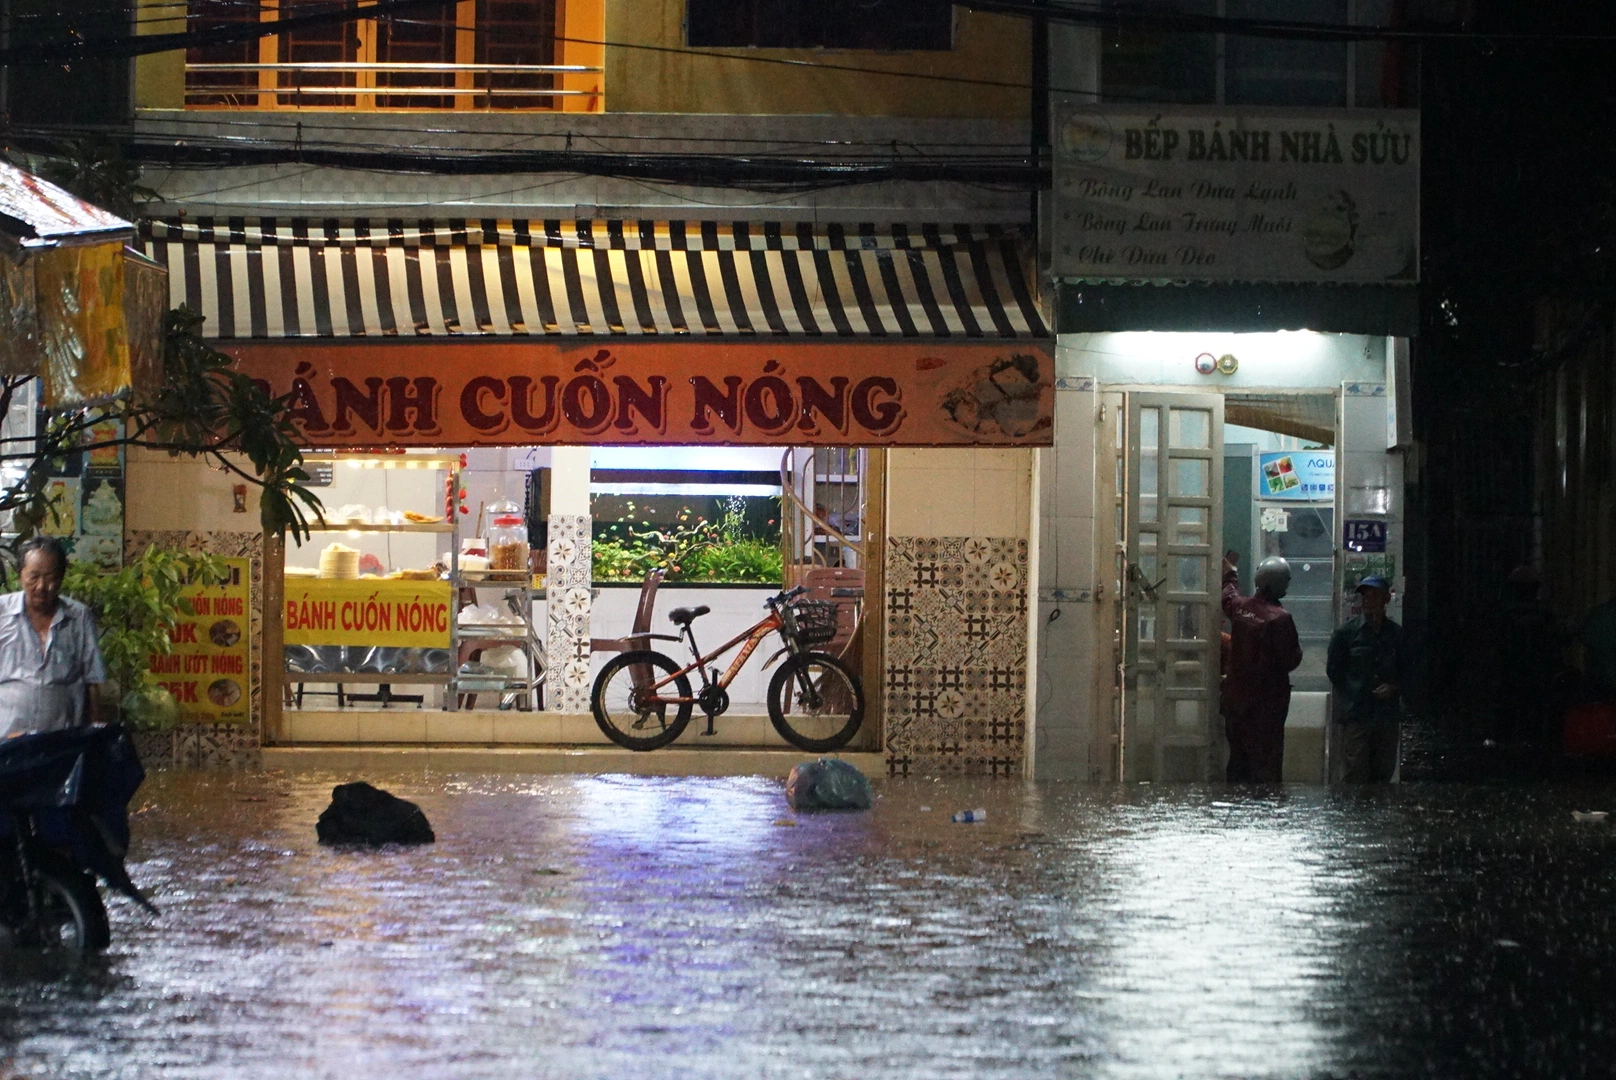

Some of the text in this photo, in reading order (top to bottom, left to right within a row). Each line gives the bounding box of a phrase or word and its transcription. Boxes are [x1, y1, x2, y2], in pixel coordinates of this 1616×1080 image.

[1125, 113, 1411, 165] BẾP BÁNH NHÀ SỬU
[1142, 178, 1183, 198] Lan
[1132, 211, 1172, 232] Lan
[250, 350, 907, 437] ÁNH CUỐN NÓNG
[1348, 523, 1382, 540] 15A
[213, 592, 243, 616] NÓNG
[286, 591, 447, 633] BÁNH CUỐN NÓNG
[212, 650, 243, 674] NÓNG
